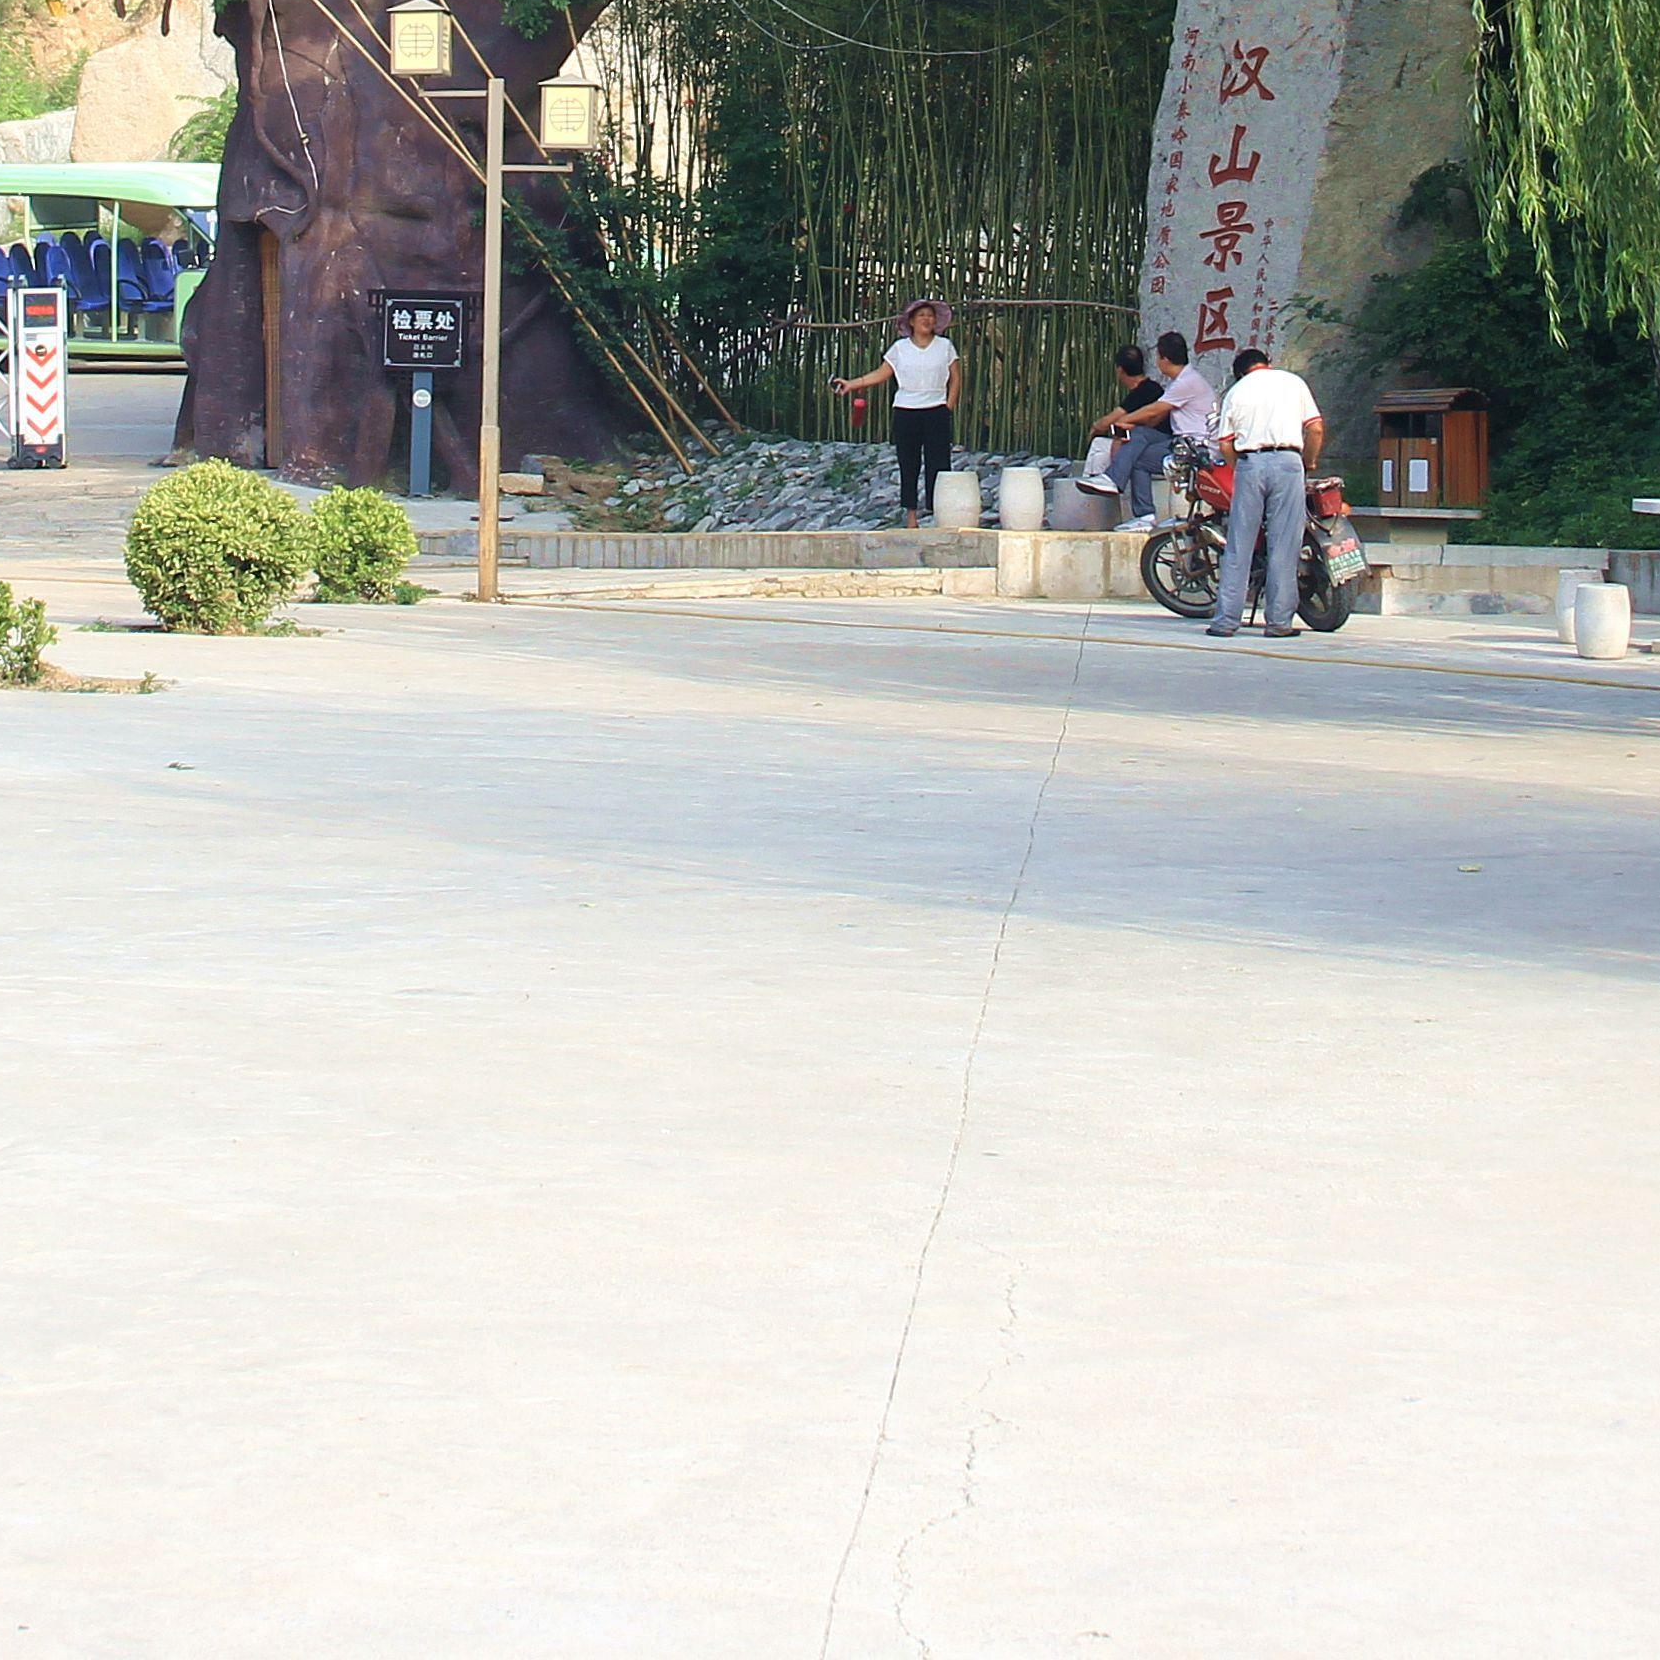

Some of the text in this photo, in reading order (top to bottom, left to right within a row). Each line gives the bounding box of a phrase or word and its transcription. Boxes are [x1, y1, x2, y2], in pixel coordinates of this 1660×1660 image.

[1194, 39, 1275, 354] 汉山景区
[392, 309, 455, 330] 检票处
[398, 333, 420, 341] Ticket
